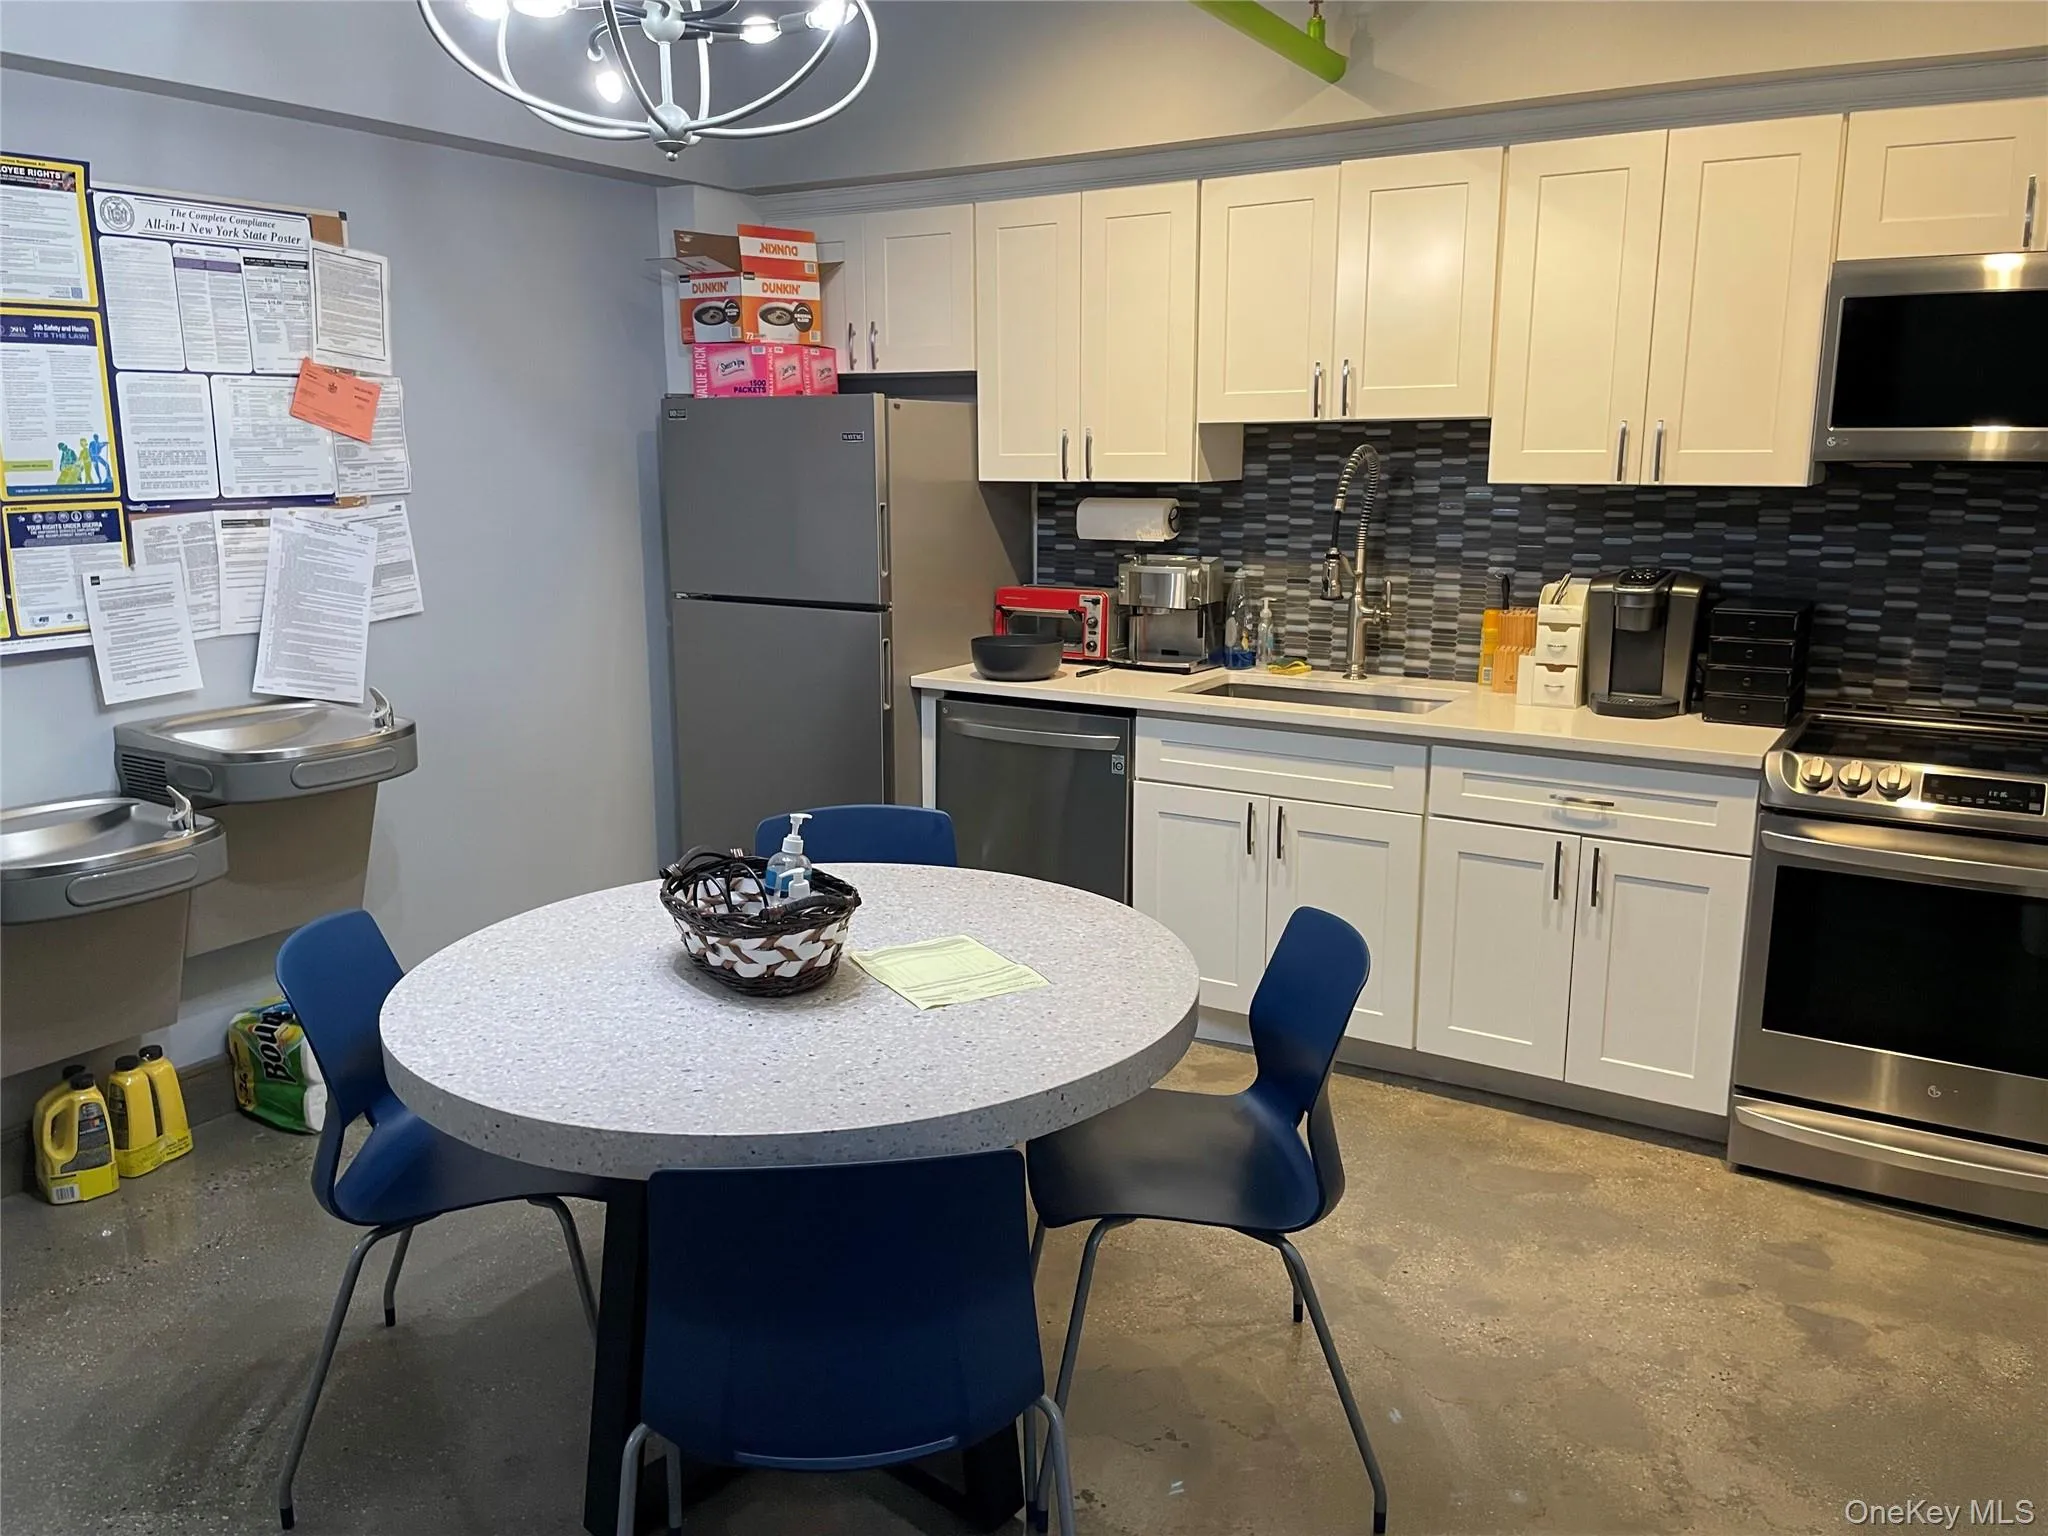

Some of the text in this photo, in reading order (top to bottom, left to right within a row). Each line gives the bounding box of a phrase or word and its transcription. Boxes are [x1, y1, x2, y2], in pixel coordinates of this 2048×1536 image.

[0, 165, 26, 176] OYEE
[27, 168, 61, 180] RIGHTS
[170, 208, 276, 229] The Complete Compliance
[144, 218, 301, 245] All-in-1 New York State Poster
[759, 242, 798, 257] DUNKIN'
[692, 281, 729, 294] DUNKIN'
[761, 282, 801, 295] DUNKIN'
[32, 323, 90, 333] Job Safety and Health
[33, 331, 49, 339] IT'S
[68, 332, 90, 340] LAW!
[694, 346, 708, 399] VALUE PACK
[733, 386, 767, 394] PACKETS
[42, 523, 62, 531] RIGHTS
